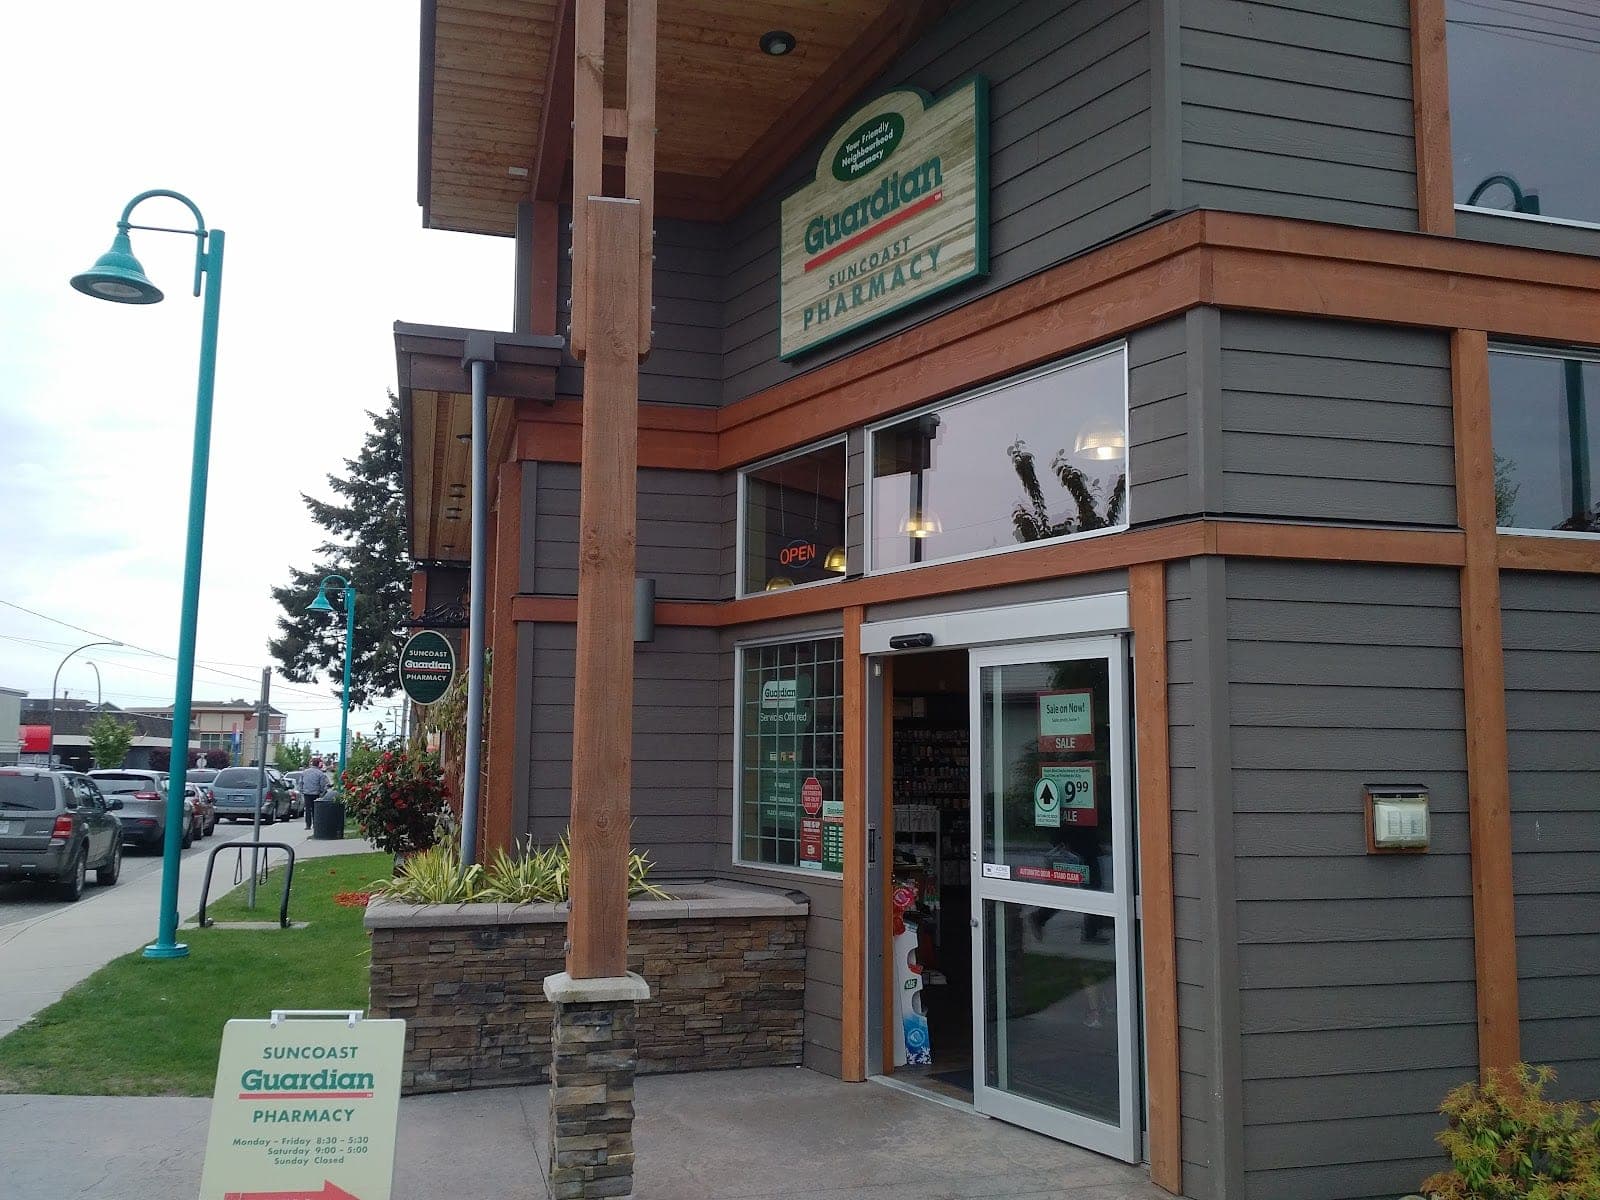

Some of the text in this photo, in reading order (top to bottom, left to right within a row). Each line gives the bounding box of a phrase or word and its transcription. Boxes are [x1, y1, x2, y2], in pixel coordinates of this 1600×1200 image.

[845, 121, 889, 153] Your Friendly
[841, 128, 894, 167] Neighbourhood
[850, 149, 884, 174] Pharmacy
[804, 155, 943, 255] Guardian
[828, 236, 911, 290] SUNCOAST
[803, 242, 943, 331] PHARMACY
[780, 543, 816, 565] OPEN
[404, 660, 451, 669] Guardian
[765, 687, 796, 698] Guadian
[1046, 702, 1085, 714] Sale on Now!
[1055, 737, 1076, 749] SALE
[1062, 810, 1078, 822] ALE
[1019, 868, 1041, 877] AUTOMATIC
[1054, 871, 1066, 879] STAND
[1067, 873, 1079, 881] CLEAR
[262, 1046, 358, 1060] SUNCOAST
[241, 1069, 375, 1091] Guardian
[252, 1108, 355, 1124] PHARMACY
[232, 1138, 271, 1147] Monday
[281, 1137, 311, 1146] Friday
[316, 1136, 337, 1145] 8:30
[347, 1136, 369, 1144] 5:30
[267, 1147, 310, 1156] Saturday
[315, 1146, 336, 1154] 9:00
[347, 1146, 368, 1154] 5:00
[274, 1155, 345, 1166] Sunday Closed
